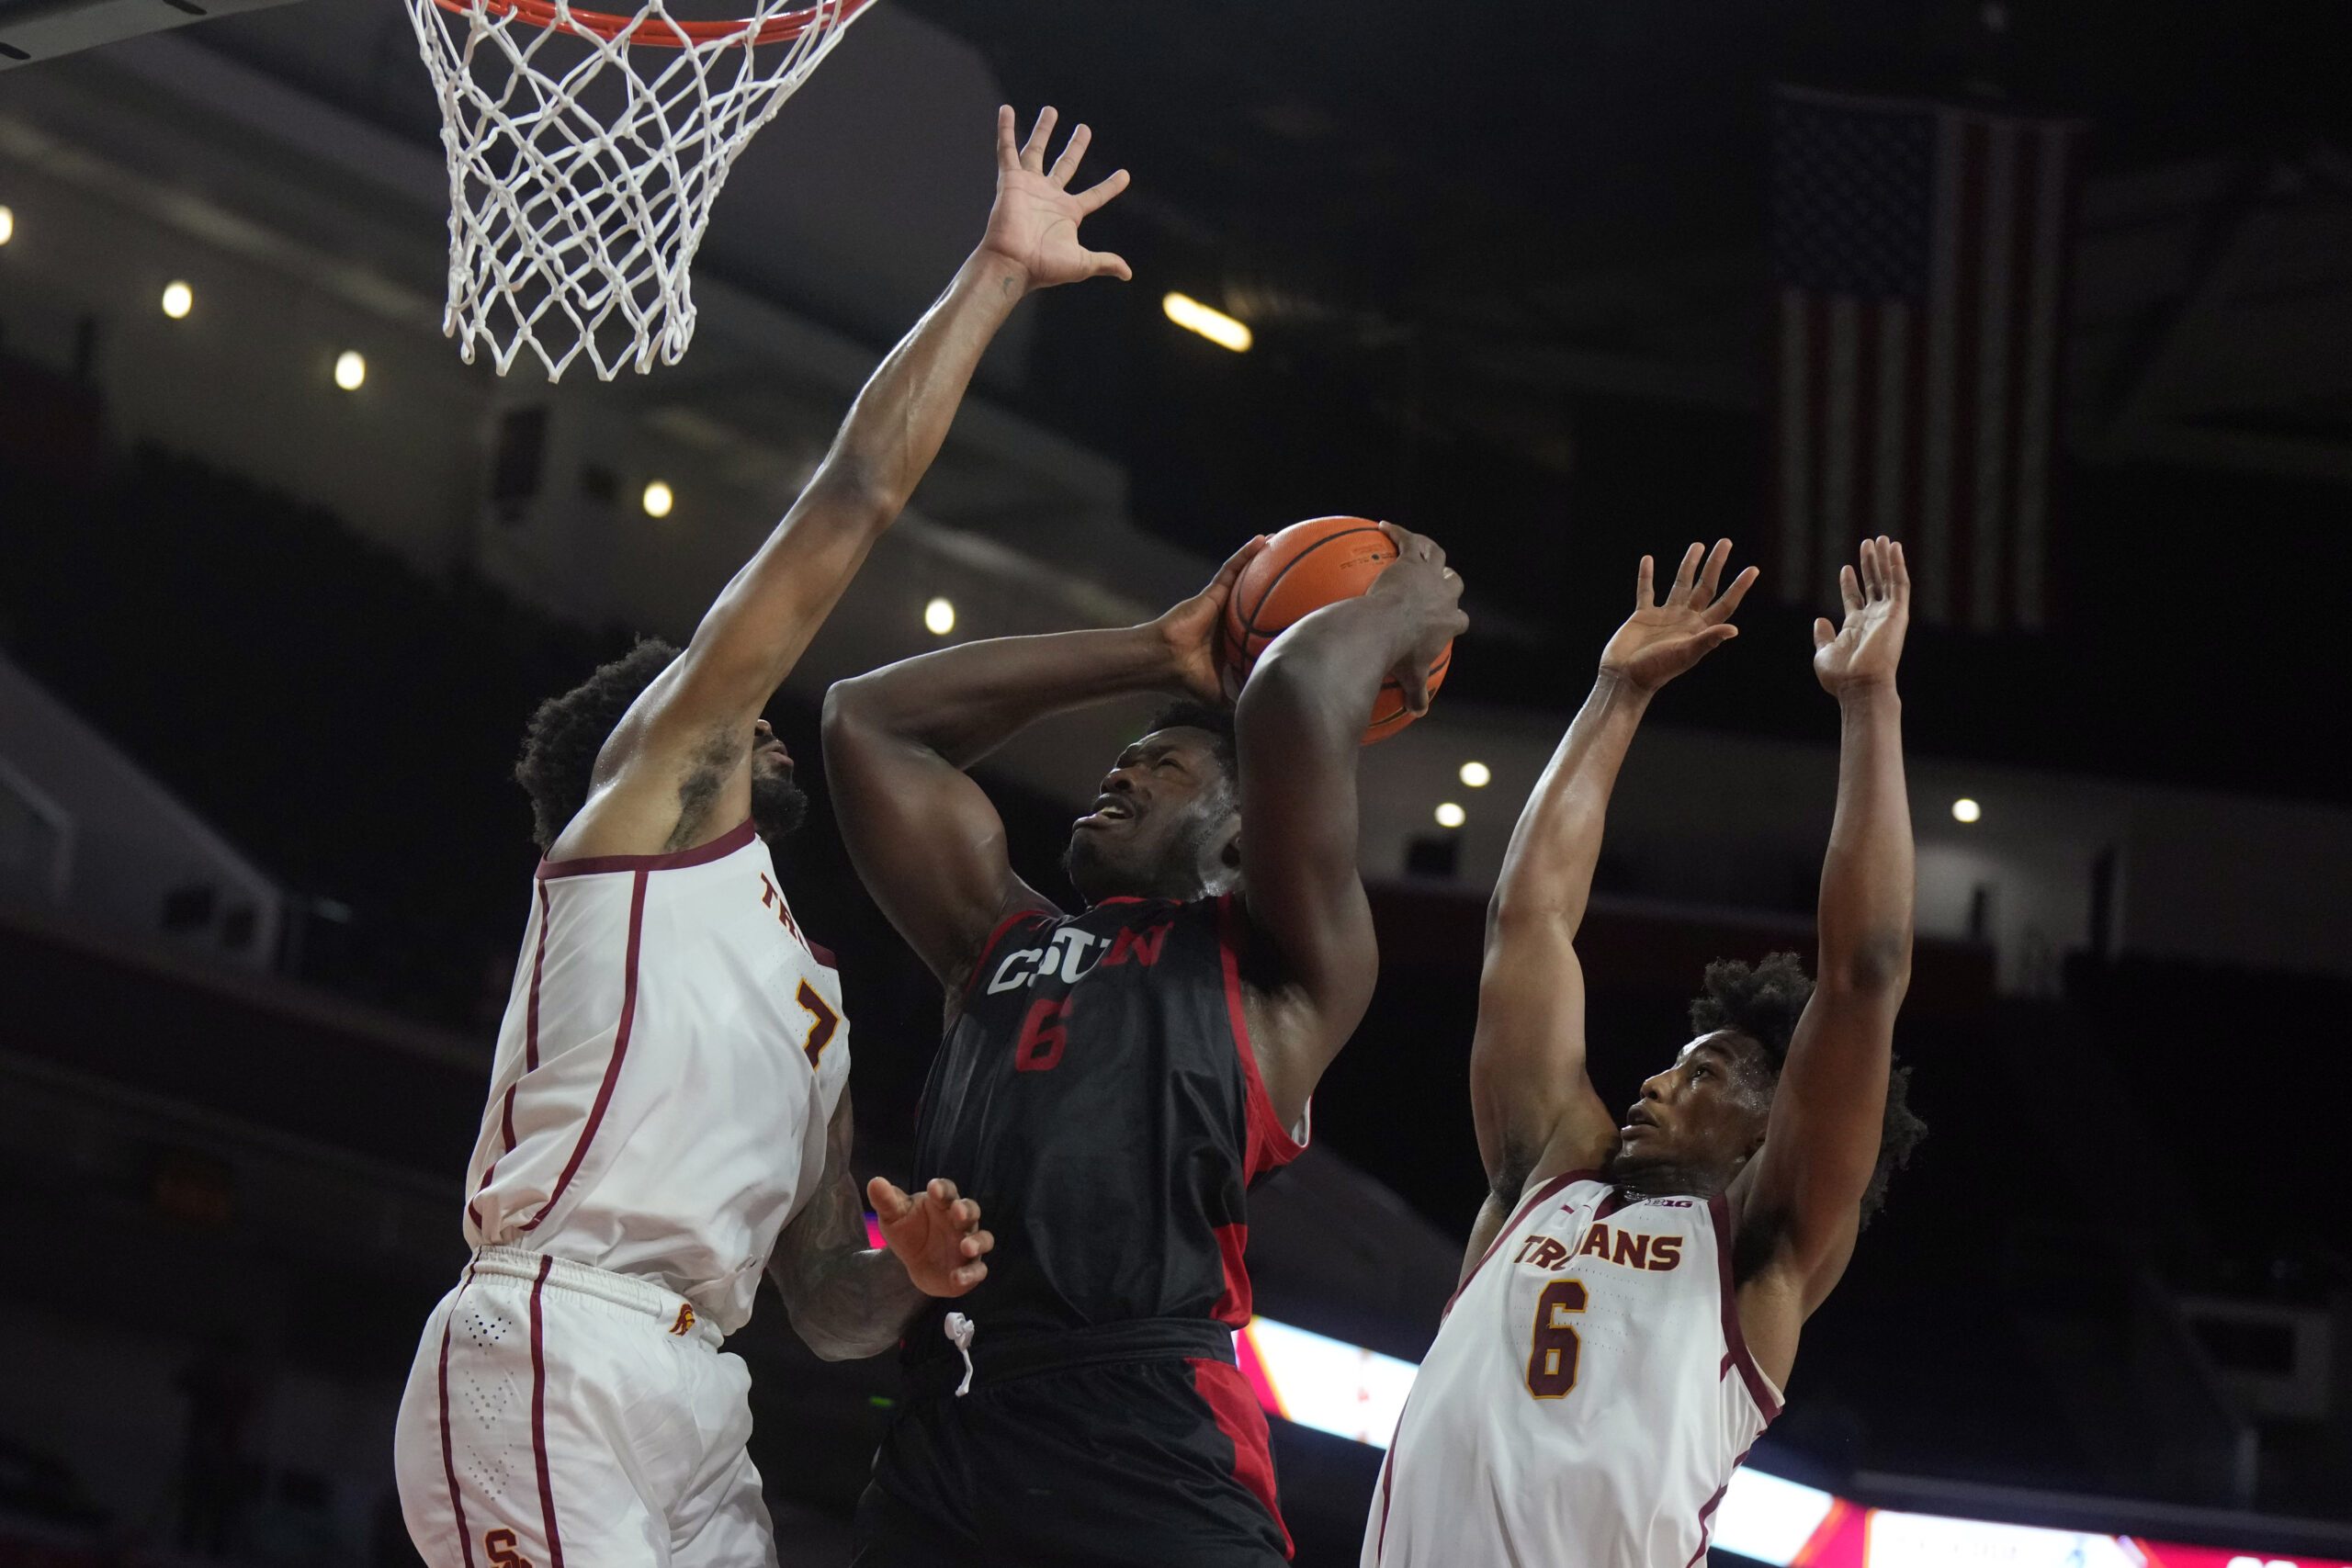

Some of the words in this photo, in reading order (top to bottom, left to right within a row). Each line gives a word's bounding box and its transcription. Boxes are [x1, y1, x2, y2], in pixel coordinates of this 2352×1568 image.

[987, 922, 1173, 995] CSUN
[796, 977, 840, 1073] 7
[1015, 999, 1073, 1072] 6
[1514, 1224, 1682, 1271] TRANS
[1526, 1280, 1588, 1399] 6
